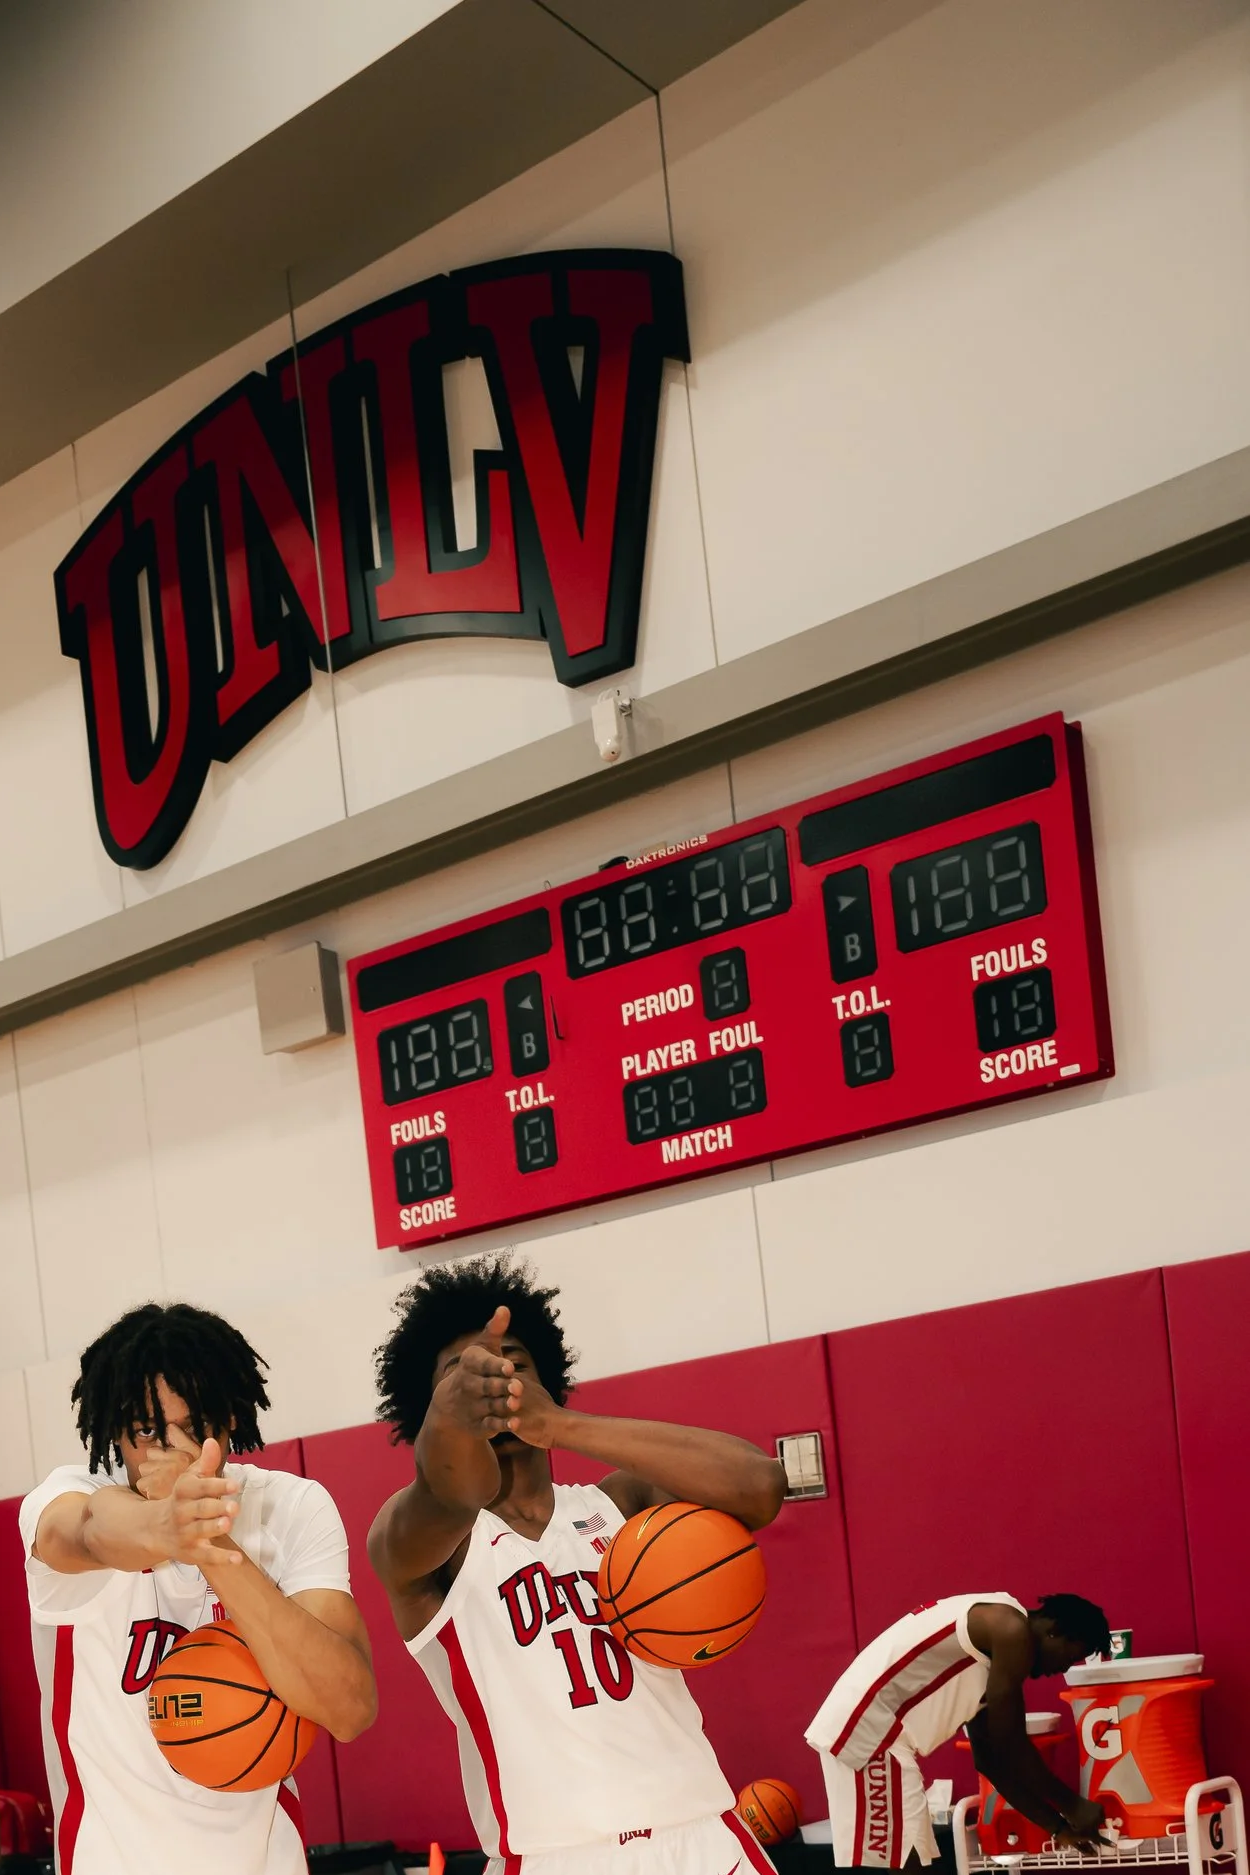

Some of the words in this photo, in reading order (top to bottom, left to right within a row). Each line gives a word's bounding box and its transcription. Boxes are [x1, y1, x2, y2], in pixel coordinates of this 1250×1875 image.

[53, 248, 690, 871] UNLV
[625, 834, 709, 870] DAKTRONICS
[969, 937, 1048, 982] FOULS
[621, 983, 695, 1027] PERIOD
[831, 985, 892, 1021] T.O.L.
[621, 1038, 698, 1081] PLAYER
[708, 1020, 764, 1056] FOUL
[979, 1039, 1059, 1084] SCORE
[504, 1081, 556, 1113] T.O.L.
[389, 1110, 448, 1146] FOULS
[660, 1124, 734, 1164] MATCH
[398, 1196, 458, 1231] SCORE
[551, 1627, 635, 1710] 10
[1081, 1705, 1123, 1761] G
